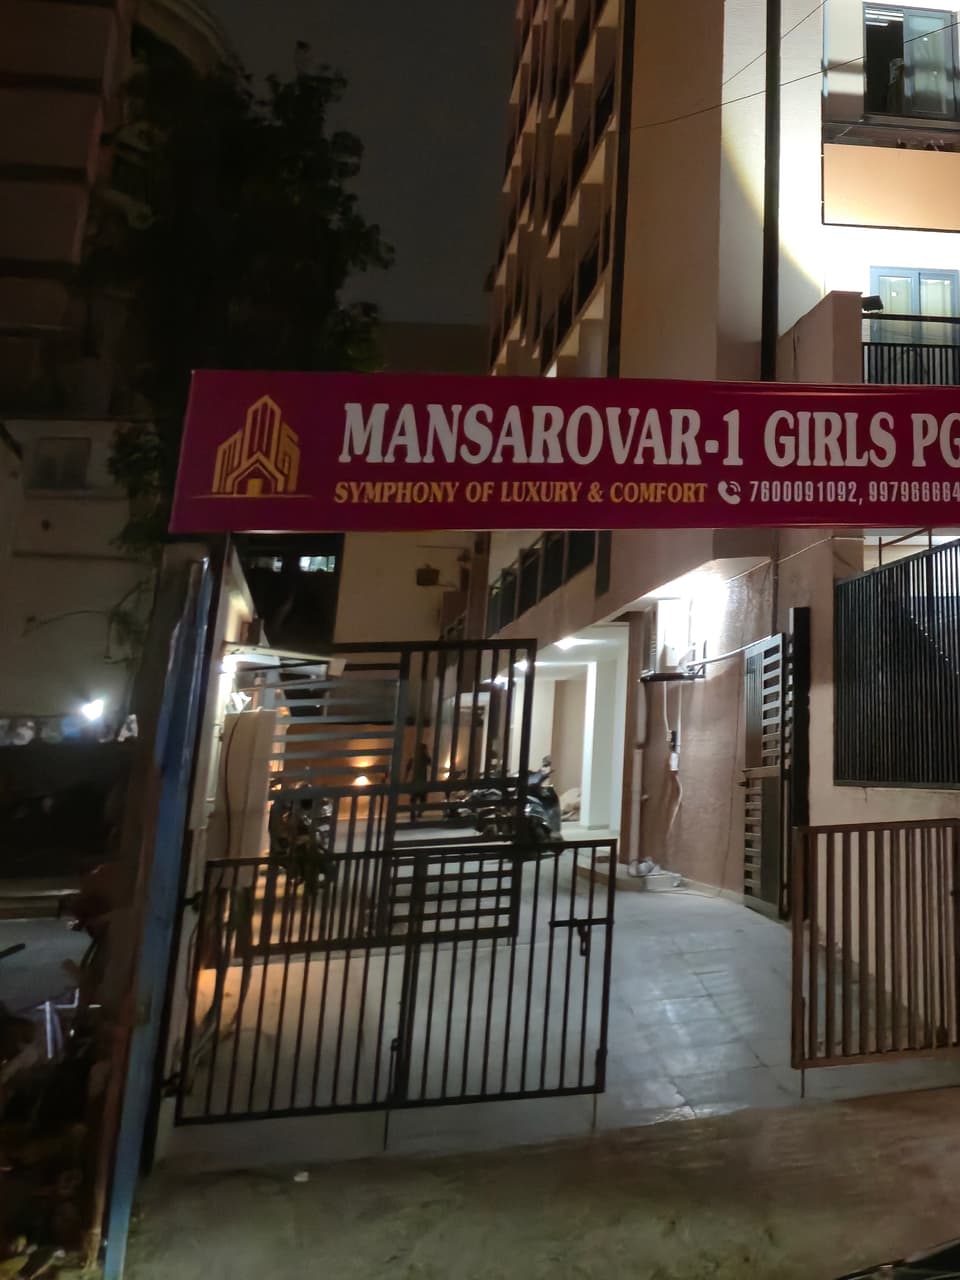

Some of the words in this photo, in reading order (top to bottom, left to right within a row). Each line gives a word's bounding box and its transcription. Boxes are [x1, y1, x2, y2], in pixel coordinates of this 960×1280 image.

[338, 402, 744, 466] MANSAROVAR-1
[763, 409, 897, 468] GIRLS
[334, 480, 460, 504] SYMPHONY
[465, 480, 495, 504] OF
[500, 480, 583, 503] LUXURY
[586, 482, 605, 504] &
[609, 481, 708, 504] COMFORT
[749, 480, 864, 506] 7600091092,
